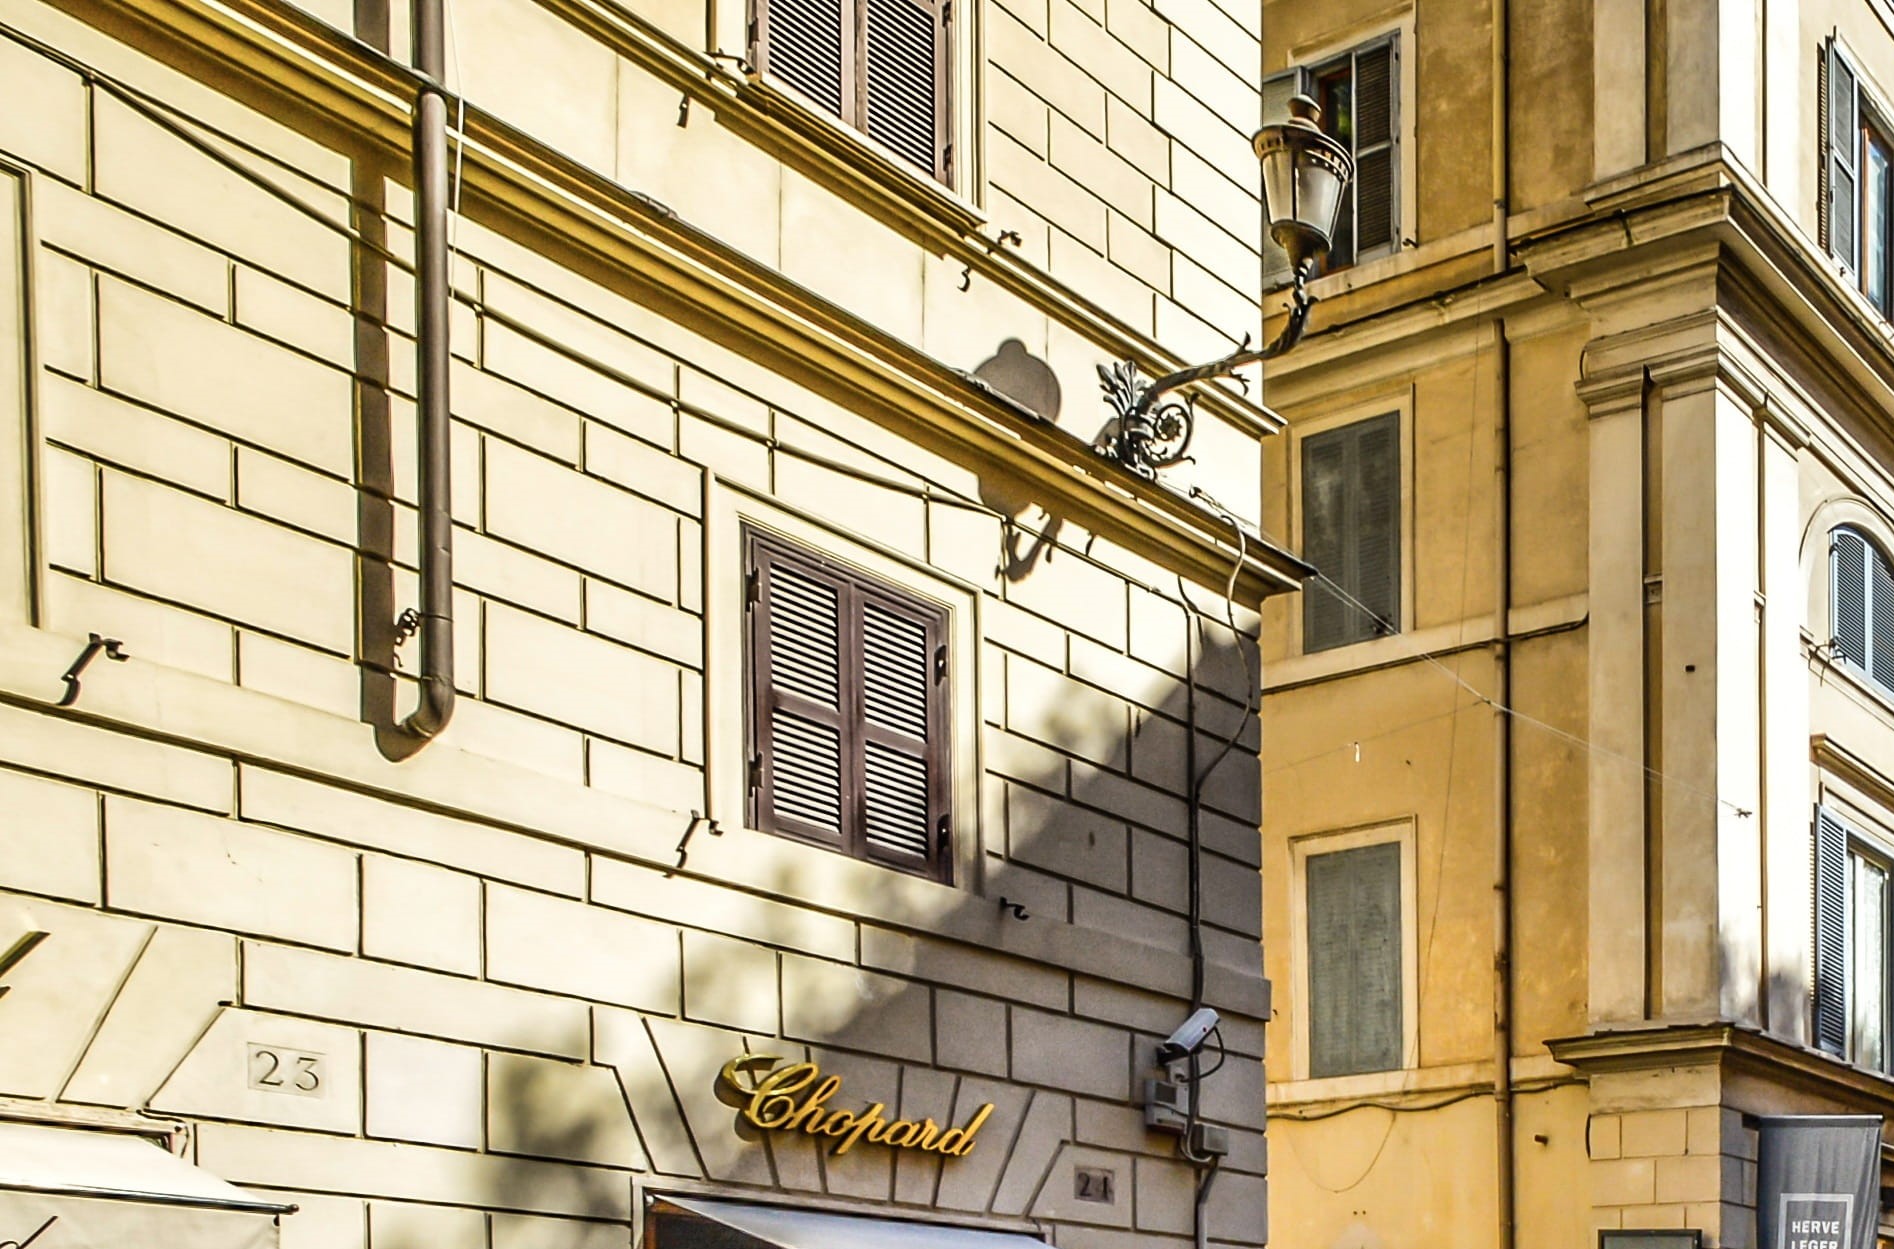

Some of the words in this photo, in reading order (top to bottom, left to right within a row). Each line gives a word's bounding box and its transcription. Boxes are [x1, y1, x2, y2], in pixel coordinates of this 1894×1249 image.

[255, 1050, 319, 1091] 23
[721, 1053, 995, 1156] Chopard
[1791, 1220, 1840, 1235] HERVE
